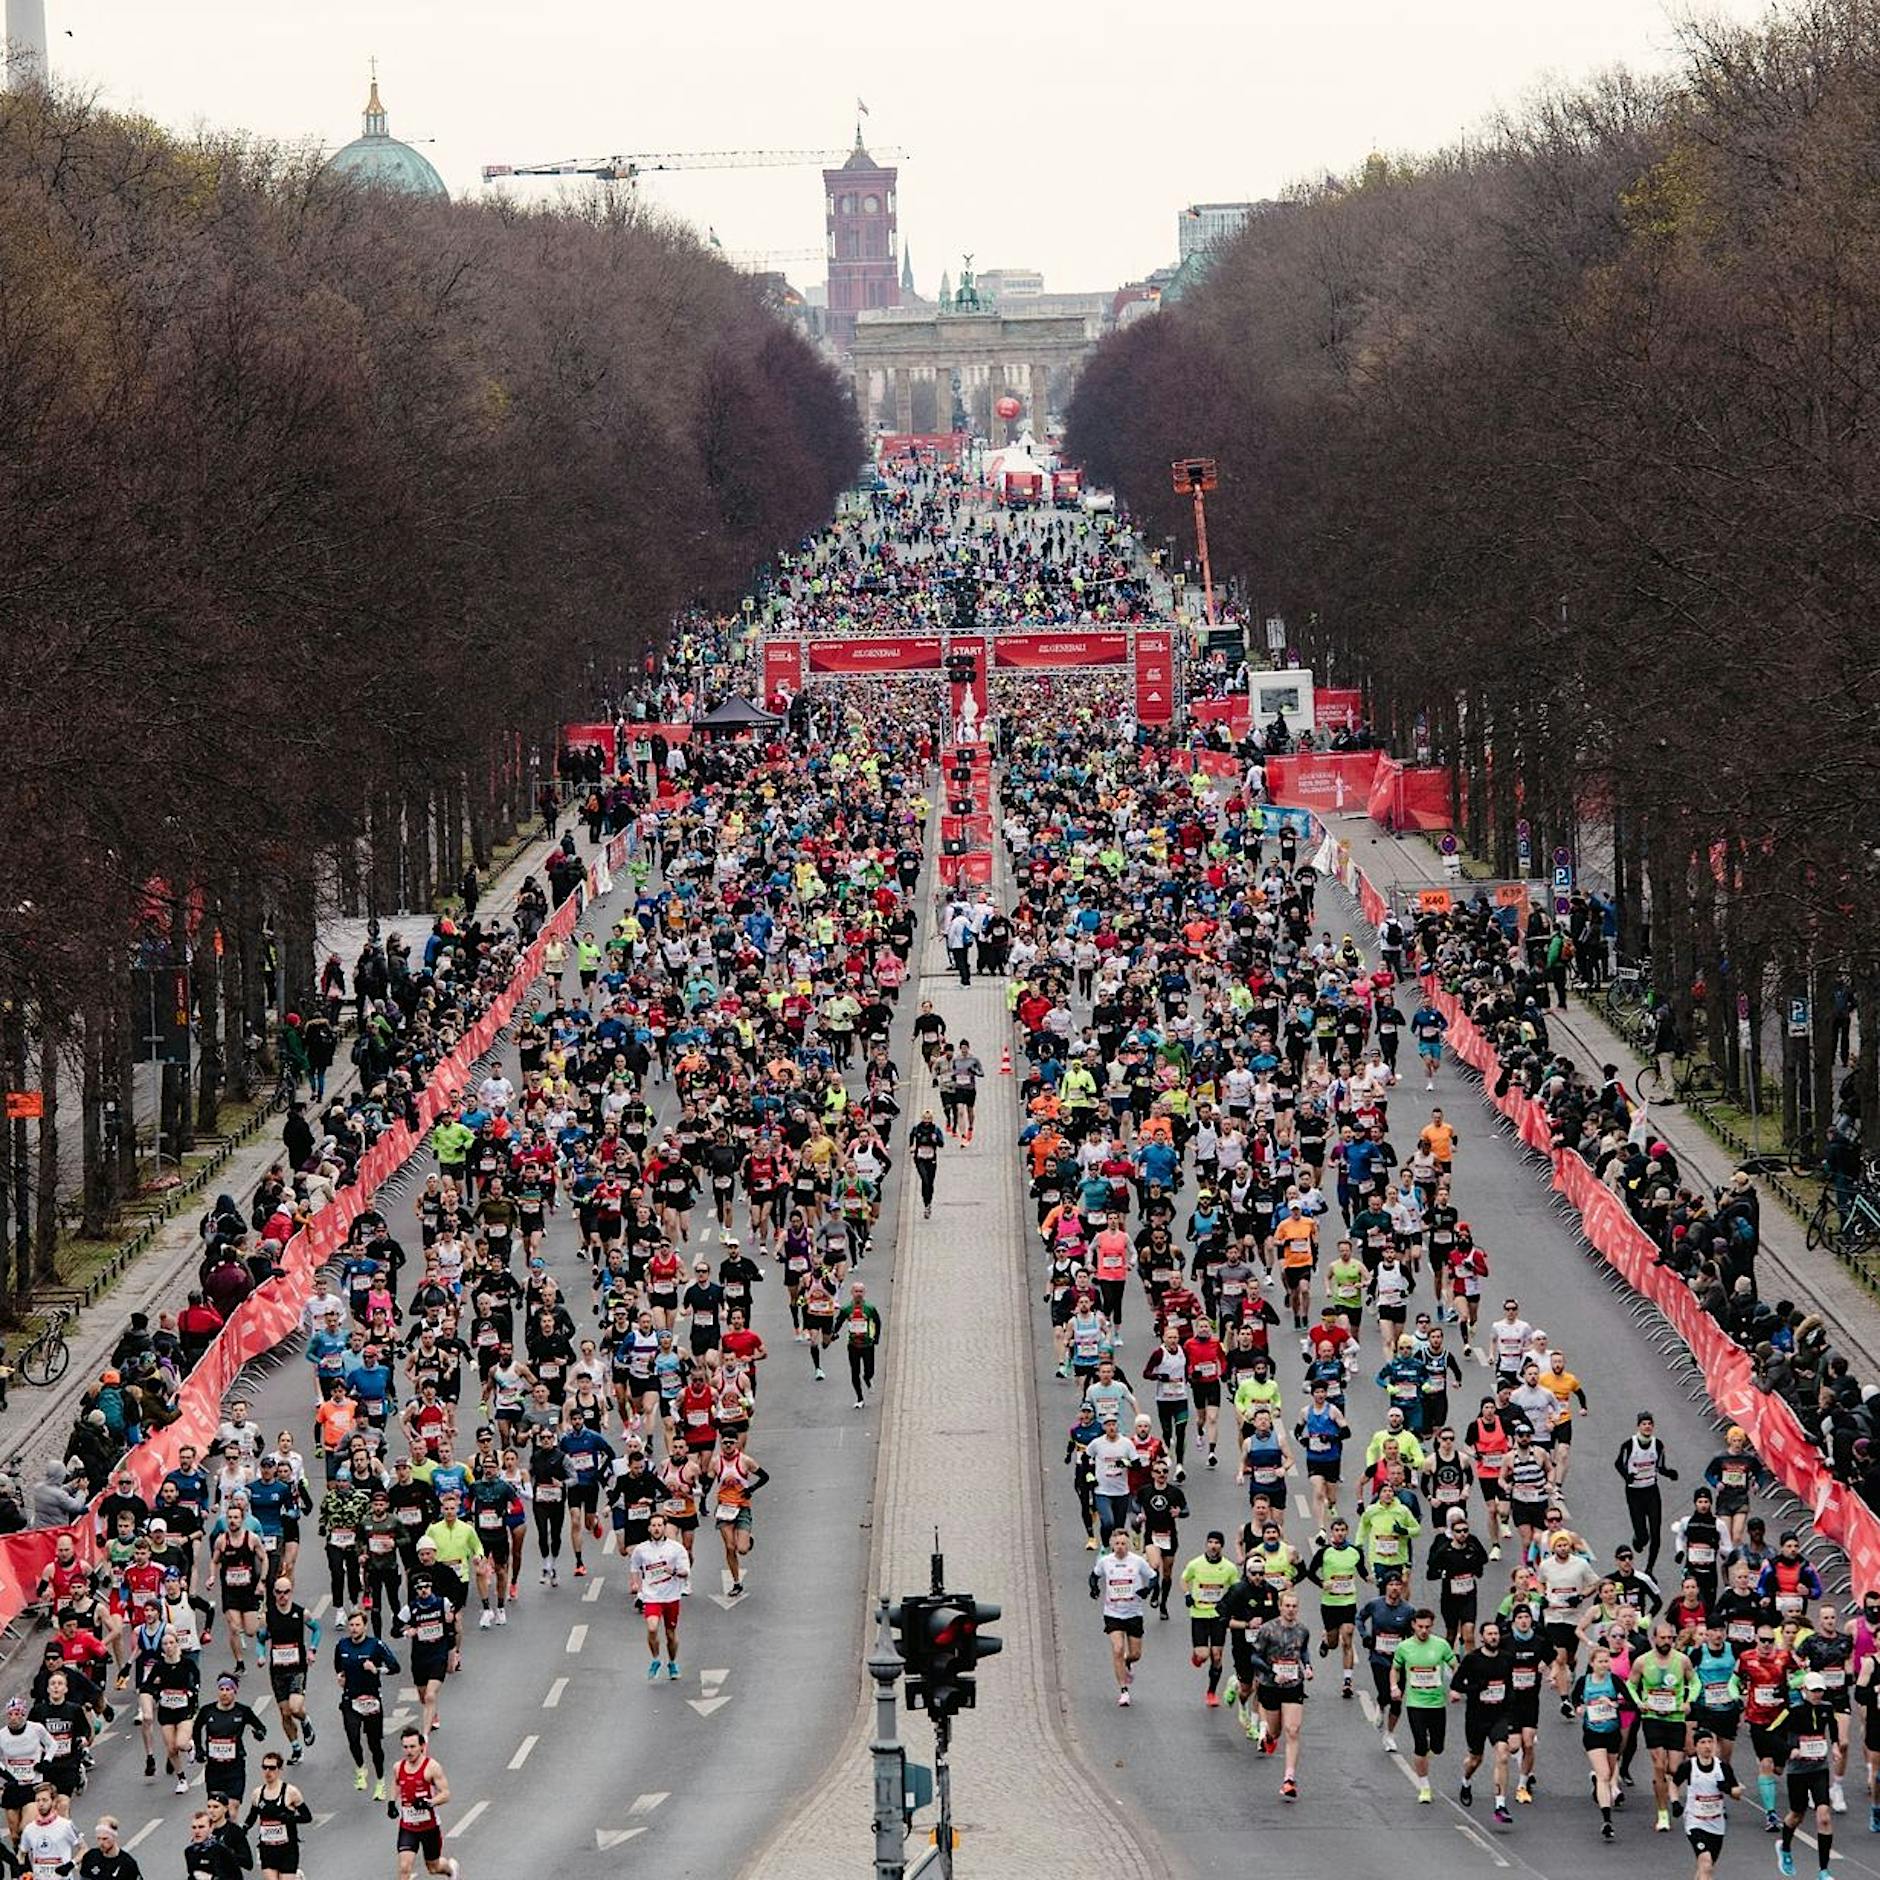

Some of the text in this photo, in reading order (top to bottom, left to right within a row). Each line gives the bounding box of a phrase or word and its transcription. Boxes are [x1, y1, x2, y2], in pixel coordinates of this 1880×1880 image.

[953, 646, 983, 656] START
[1502, 888, 1522, 898] K39
[1425, 896, 1444, 906] K40
